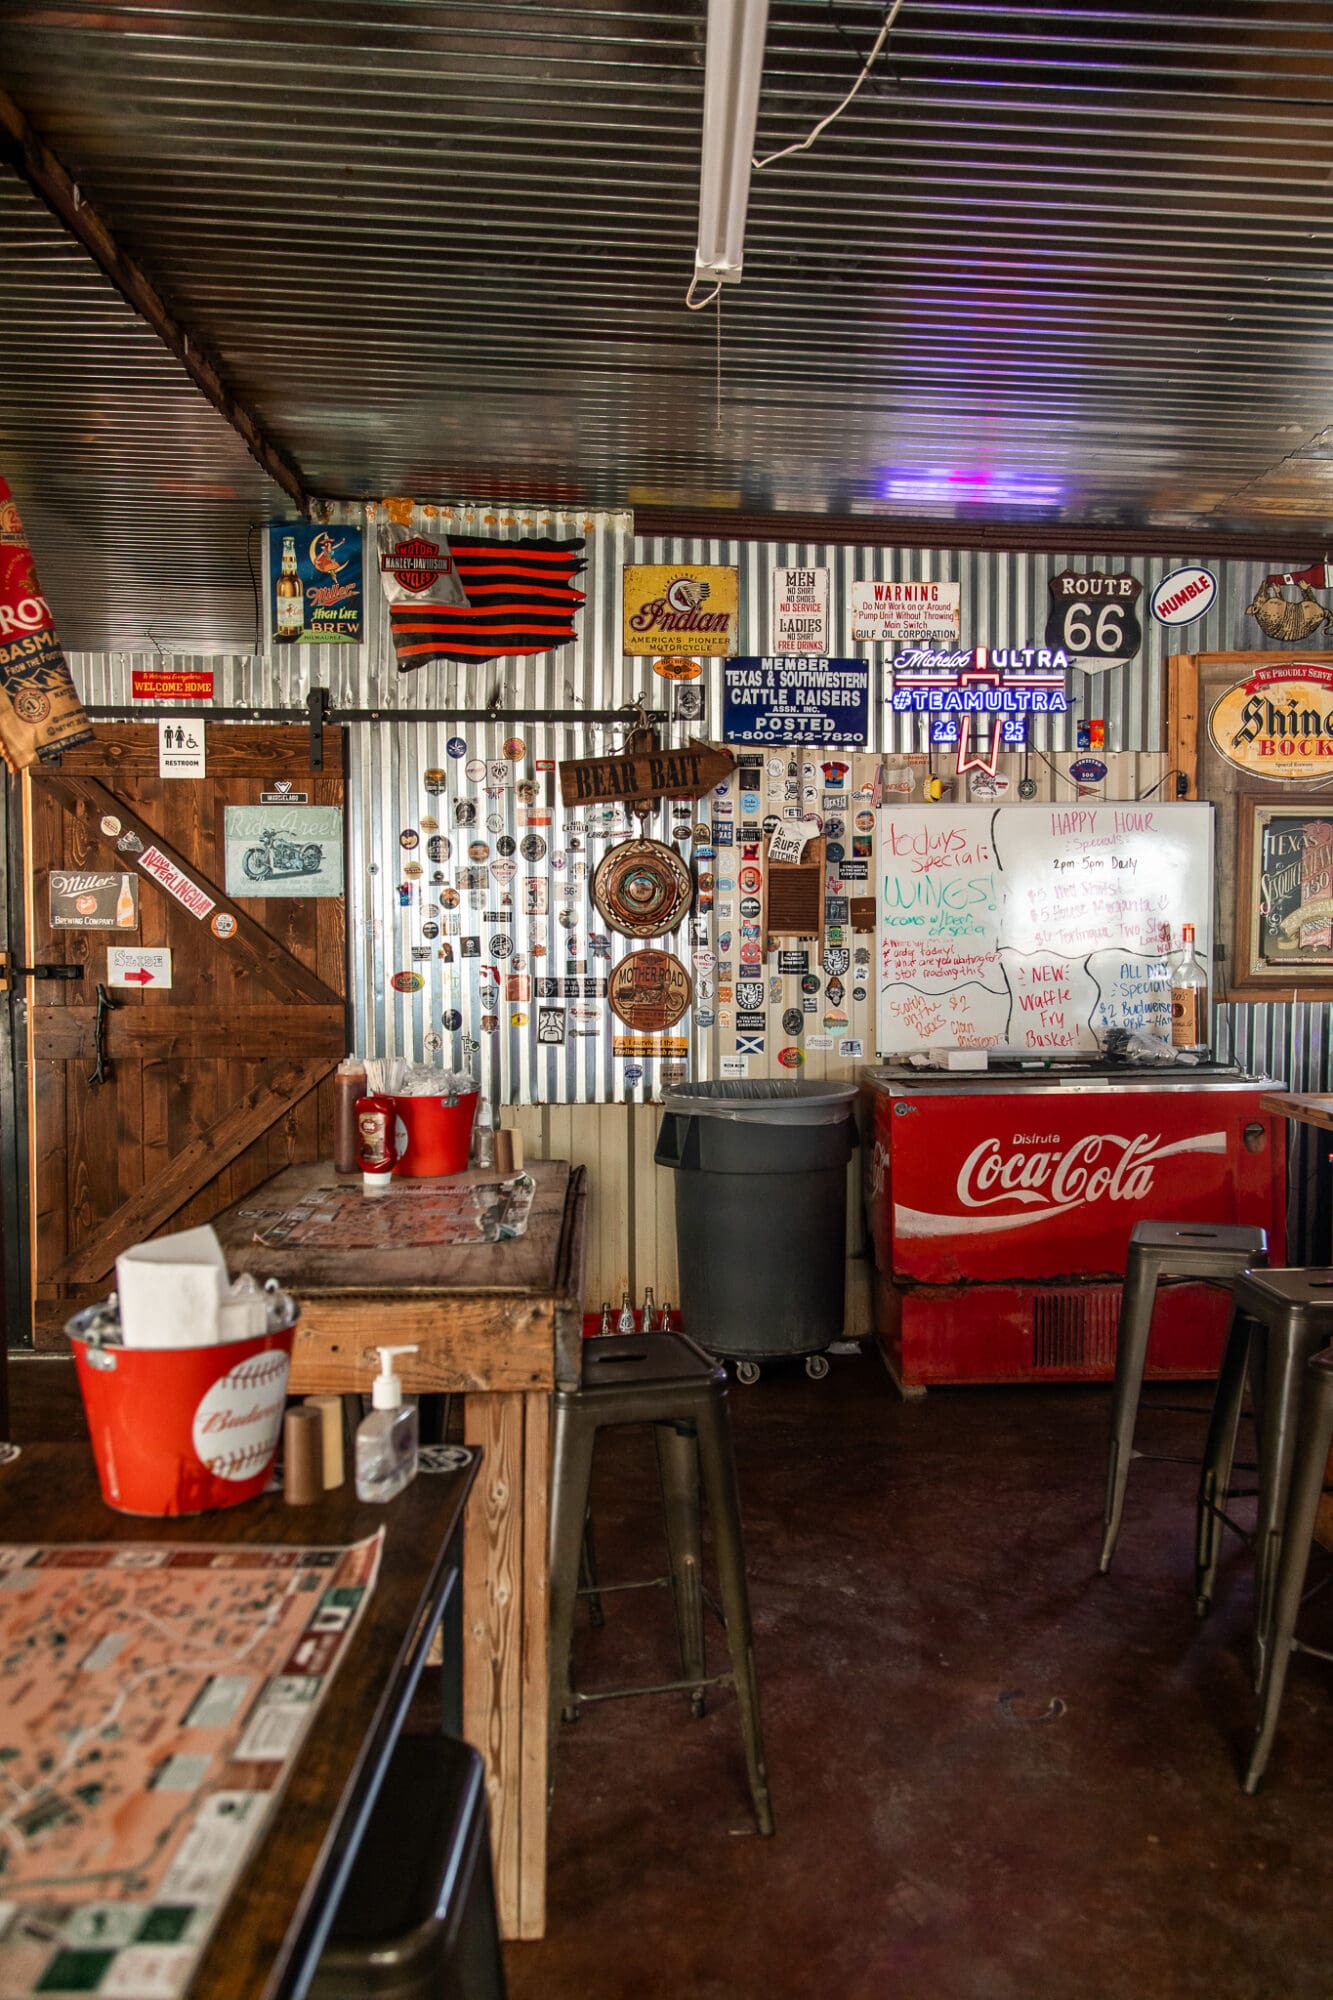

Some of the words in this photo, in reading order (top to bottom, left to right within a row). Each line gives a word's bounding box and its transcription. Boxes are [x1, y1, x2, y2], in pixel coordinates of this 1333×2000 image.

[400, 542, 433, 554] MOTOR
[385, 557, 448, 570] HARLEY-DAVIDSON
[400, 572, 431, 587] CYCLES
[786, 572, 816, 586] MEN
[1062, 578, 1132, 596] ROUTE
[306, 583, 359, 606] Miller
[874, 585, 939, 601] WARNING
[1156, 575, 1211, 618] HUMBLE
[780, 603, 791, 612] NO
[792, 603, 821, 612] SERVICE
[862, 602, 873, 610] Do
[874, 602, 886, 610] Not
[888, 602, 905, 610] Work
[629, 598, 730, 632] Indian
[858, 611, 878, 621] Pump
[880, 611, 894, 619] Unit
[896, 611, 921, 619] Without
[924, 611, 954, 622] Throwing
[311, 623, 359, 633] BREW
[780, 619, 822, 632] LADIES
[884, 621, 901, 629] Main
[903, 621, 928, 629] Switch
[1064, 602, 1125, 652] 66
[631, 636, 682, 644] AMERICA'S
[688, 637, 730, 645] PIONEER
[855, 630, 876, 638] GULF
[881, 630, 894, 638] OIL
[898, 630, 955, 638] CORPORATION
[778, 641, 795, 650] FREE
[797, 641, 823, 650] DRINKS
[762, 658, 829, 671] MEMBER
[893, 649, 973, 668] Michelob
[992, 649, 1068, 668] ULTRA
[135, 682, 184, 692] WELCOME
[184, 682, 211, 692] HOME
[725, 670, 762, 686] TEXAS
[767, 671, 775, 687] &
[780, 671, 867, 688] SOUTHWESTERN
[731, 688, 787, 705] CATTLE
[796, 690, 860, 706] RAISERS
[893, 690, 1067, 711] #TEAMULTRA
[756, 718, 835, 731] POSTED
[934, 721, 957, 735] 26
[1004, 721, 1024, 735] 95
[727, 730, 864, 742] 1-800-242-7820
[575, 762, 640, 800] BEAR
[650, 754, 702, 791] BAIT
[229, 810, 275, 837] Ride
[278, 810, 338, 837] Free!
[1051, 811, 1098, 836] HAPPY
[1114, 811, 1158, 833] HOUR
[781, 840, 794, 851] UP
[882, 823, 967, 856] todays
[1073, 834, 1123, 850] Specials
[1266, 831, 1318, 856] TEXAS
[770, 850, 799, 864] BITCHES
[1112, 856, 1138, 874] Daily
[52, 875, 116, 896] Miller
[884, 872, 997, 911] WINGS!
[1304, 871, 1329, 900] 150
[54, 915, 83, 925] BREWING
[84, 916, 115, 925] COMPANY
[1119, 921, 1141, 938] Two
[113, 950, 163, 968] SLIDE
[823, 949, 849, 958] BBQ
[618, 967, 657, 985] MOTHER
[657, 968, 684, 988] ROAD
[1032, 965, 1065, 983] NEW
[1120, 964, 1142, 979] ALL
[1145, 962, 1170, 978] DAY
[737, 983, 763, 992] BBQ
[948, 993, 970, 1013] $2
[1018, 989, 1072, 1012] Waffle
[1121, 1000, 1171, 1015] Budweise
[1040, 1011, 1065, 1028] Fry
[1026, 1023, 1080, 1048] Basket!
[1012, 1133, 1061, 1145] Disfruta
[957, 1132, 1161, 1207] Coca-Cola
